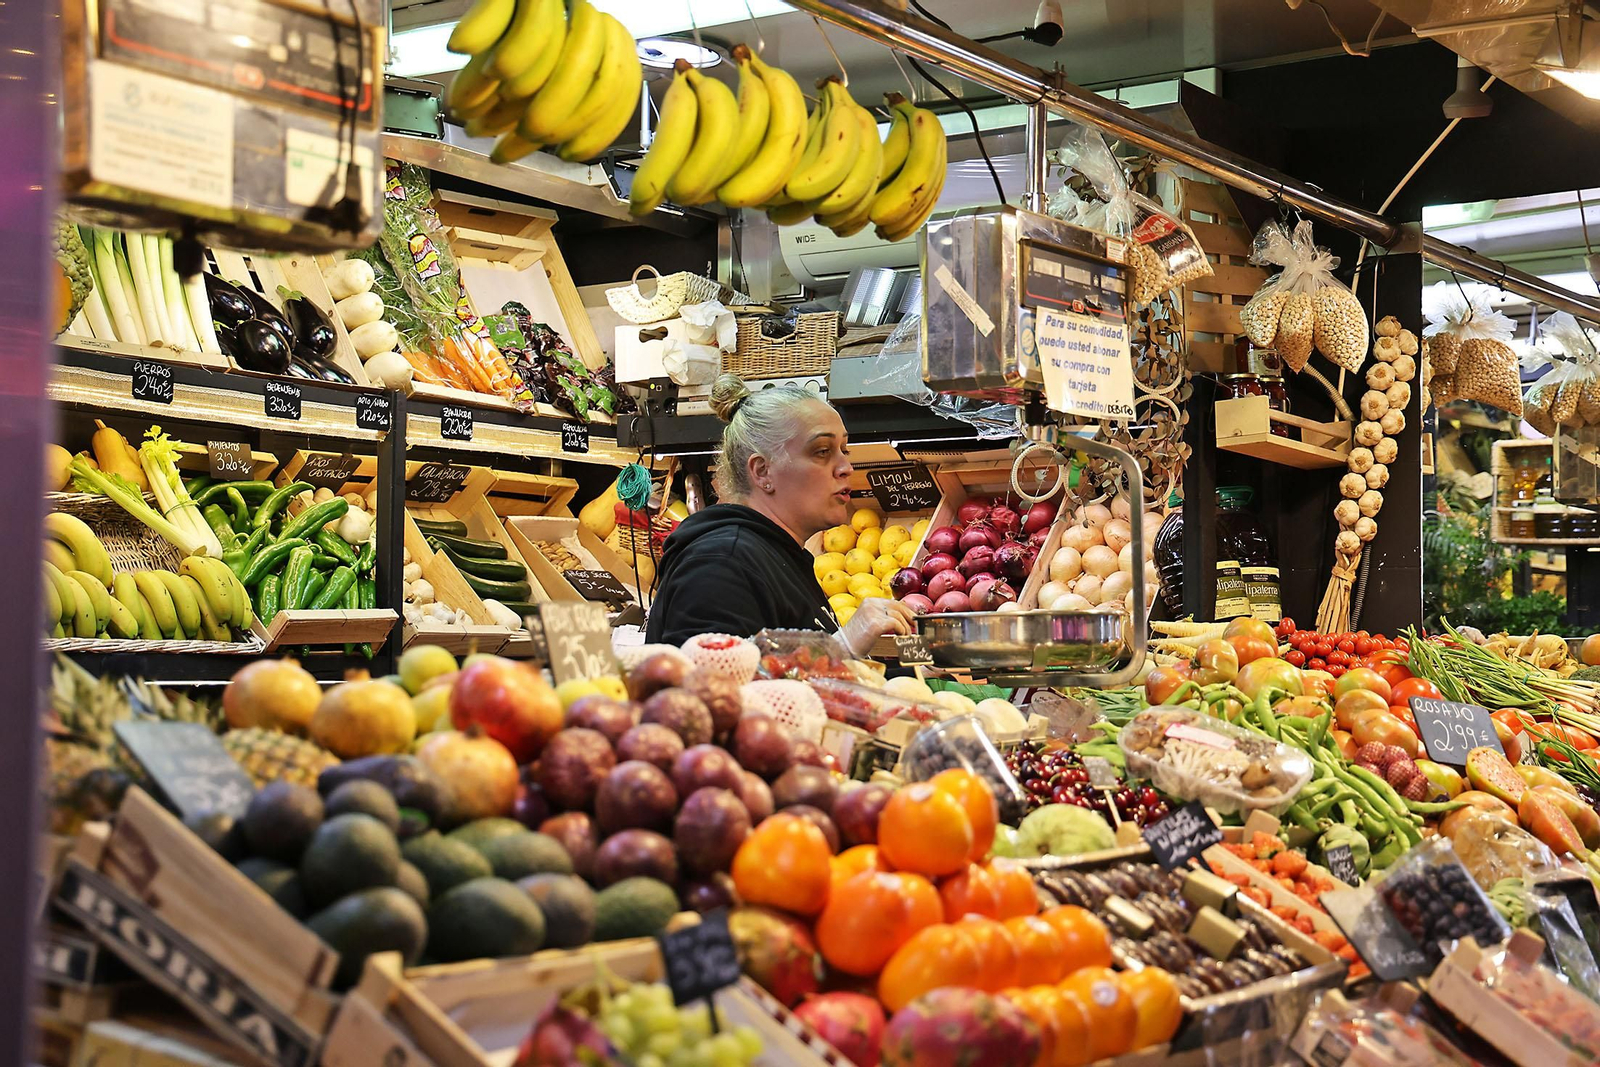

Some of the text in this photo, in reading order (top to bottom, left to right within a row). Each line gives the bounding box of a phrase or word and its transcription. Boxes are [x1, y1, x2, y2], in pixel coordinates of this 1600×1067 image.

[795, 234, 816, 244] WIDE
[1045, 315, 1065, 328] Para
[1067, 321, 1077, 331] su
[1039, 336, 1066, 349] puede
[1068, 341, 1092, 353] usted
[134, 361, 172, 378] PUERROS
[1051, 357, 1111, 376] su compra con
[1068, 379, 1097, 393] tarjeta
[870, 470, 913, 487] LIMON
[1413, 697, 1475, 722] ROSADO
